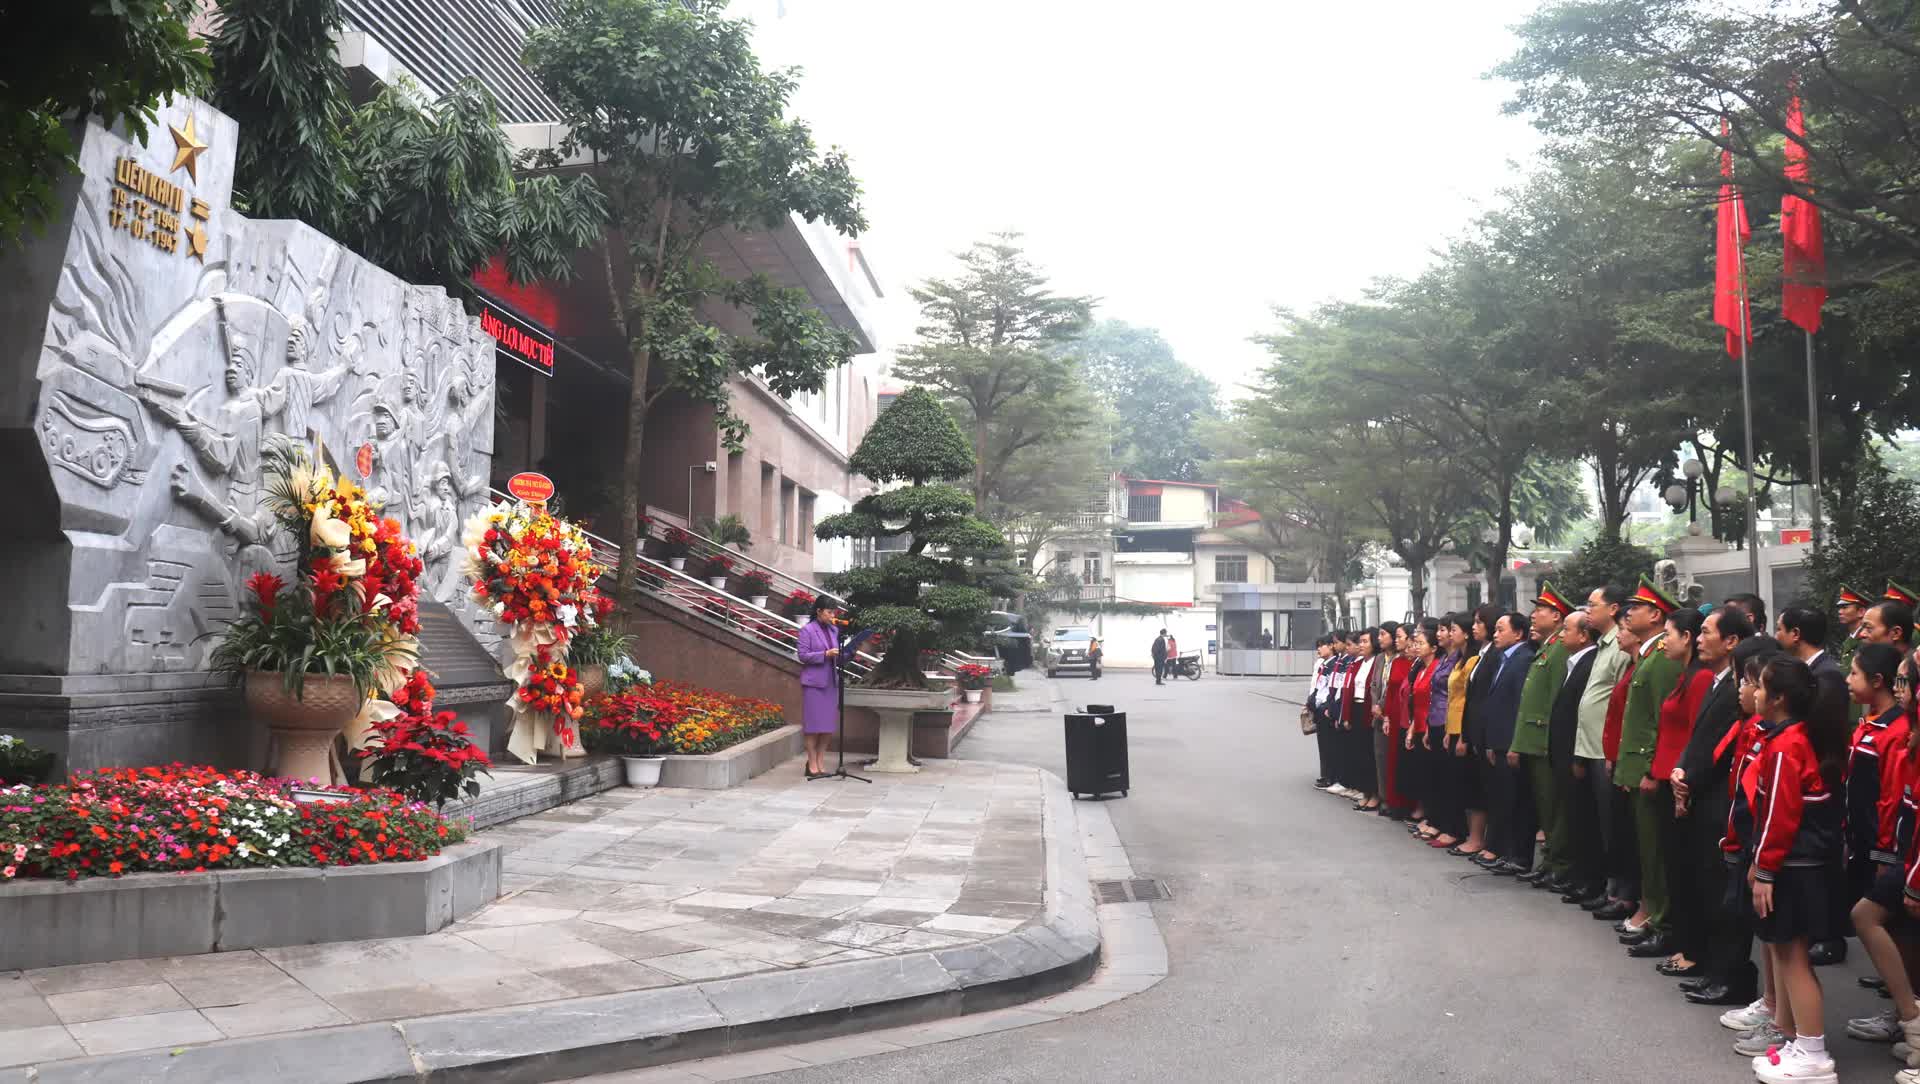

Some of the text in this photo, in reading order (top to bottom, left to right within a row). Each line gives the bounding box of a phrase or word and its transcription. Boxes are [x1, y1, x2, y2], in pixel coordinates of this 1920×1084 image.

[115, 156, 149, 198] LIÊN
[148, 172, 174, 207] KHU
[480, 307, 502, 340] ẮNG
